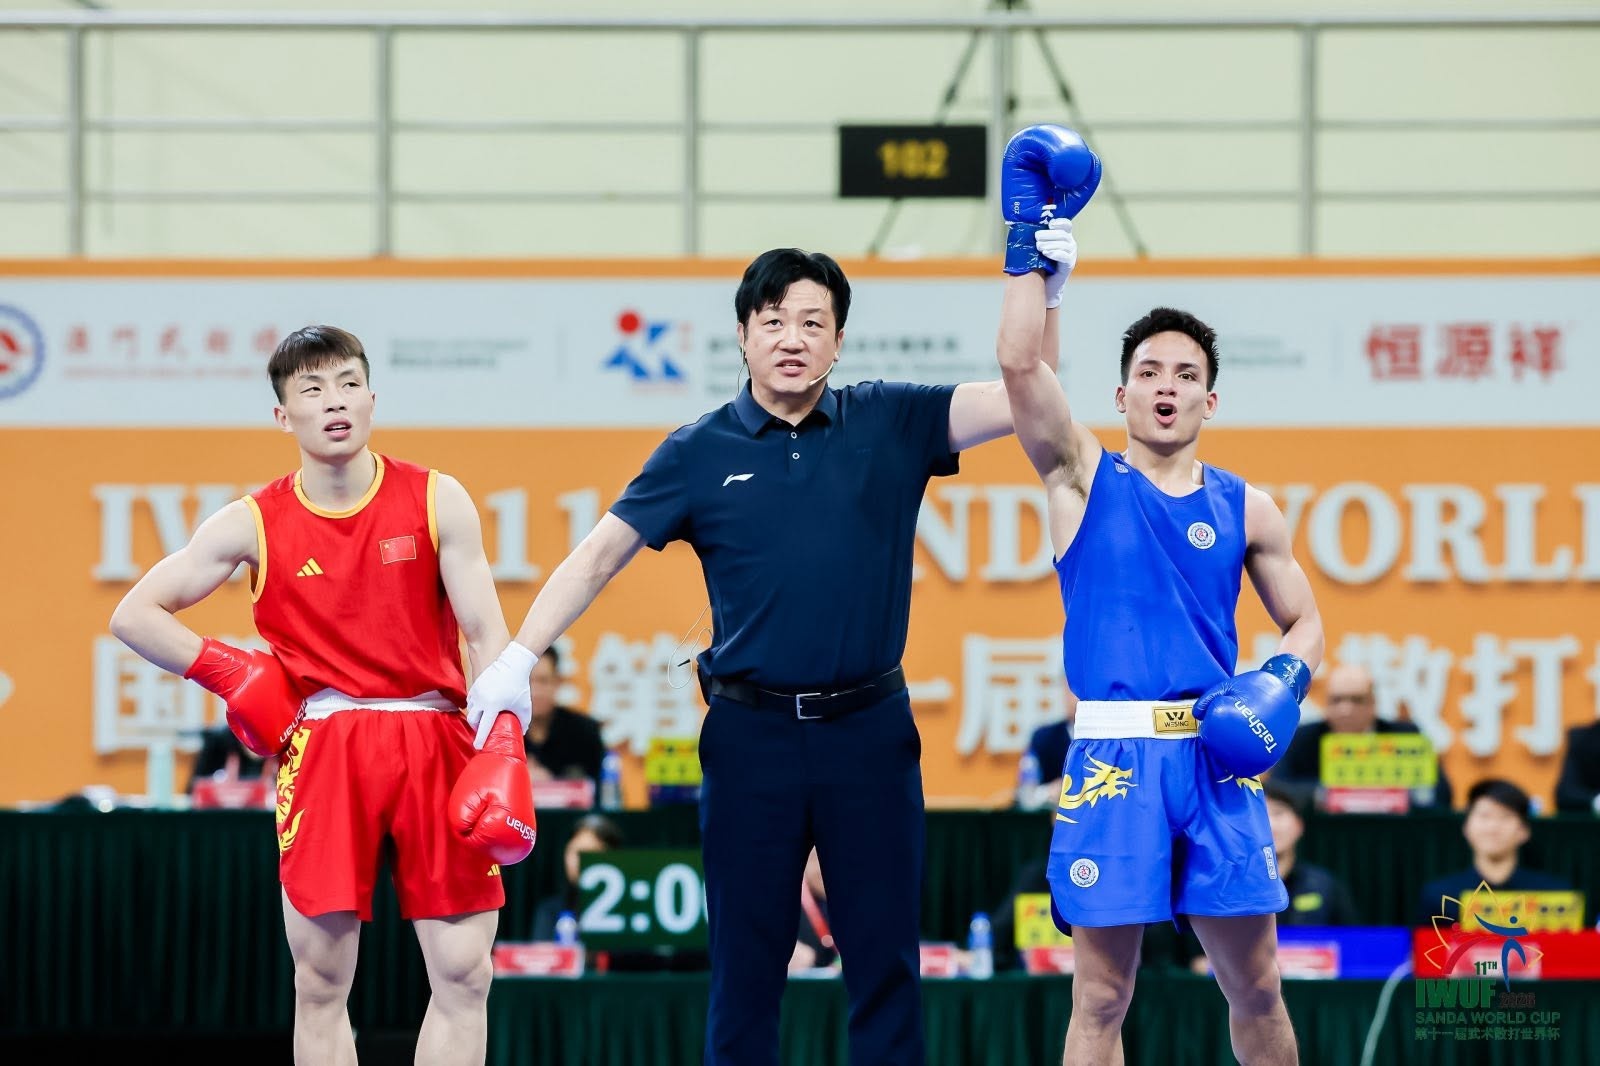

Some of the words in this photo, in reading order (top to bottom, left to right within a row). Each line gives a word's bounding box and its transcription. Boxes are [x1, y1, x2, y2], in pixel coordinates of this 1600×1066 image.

[1364, 322, 1567, 382] 恒源祥
[1262, 482, 1600, 584] ORL
[1164, 720, 1189, 728] WESING
[1234, 700, 1278, 754] TaiShan
[579, 862, 708, 934] 2:0
